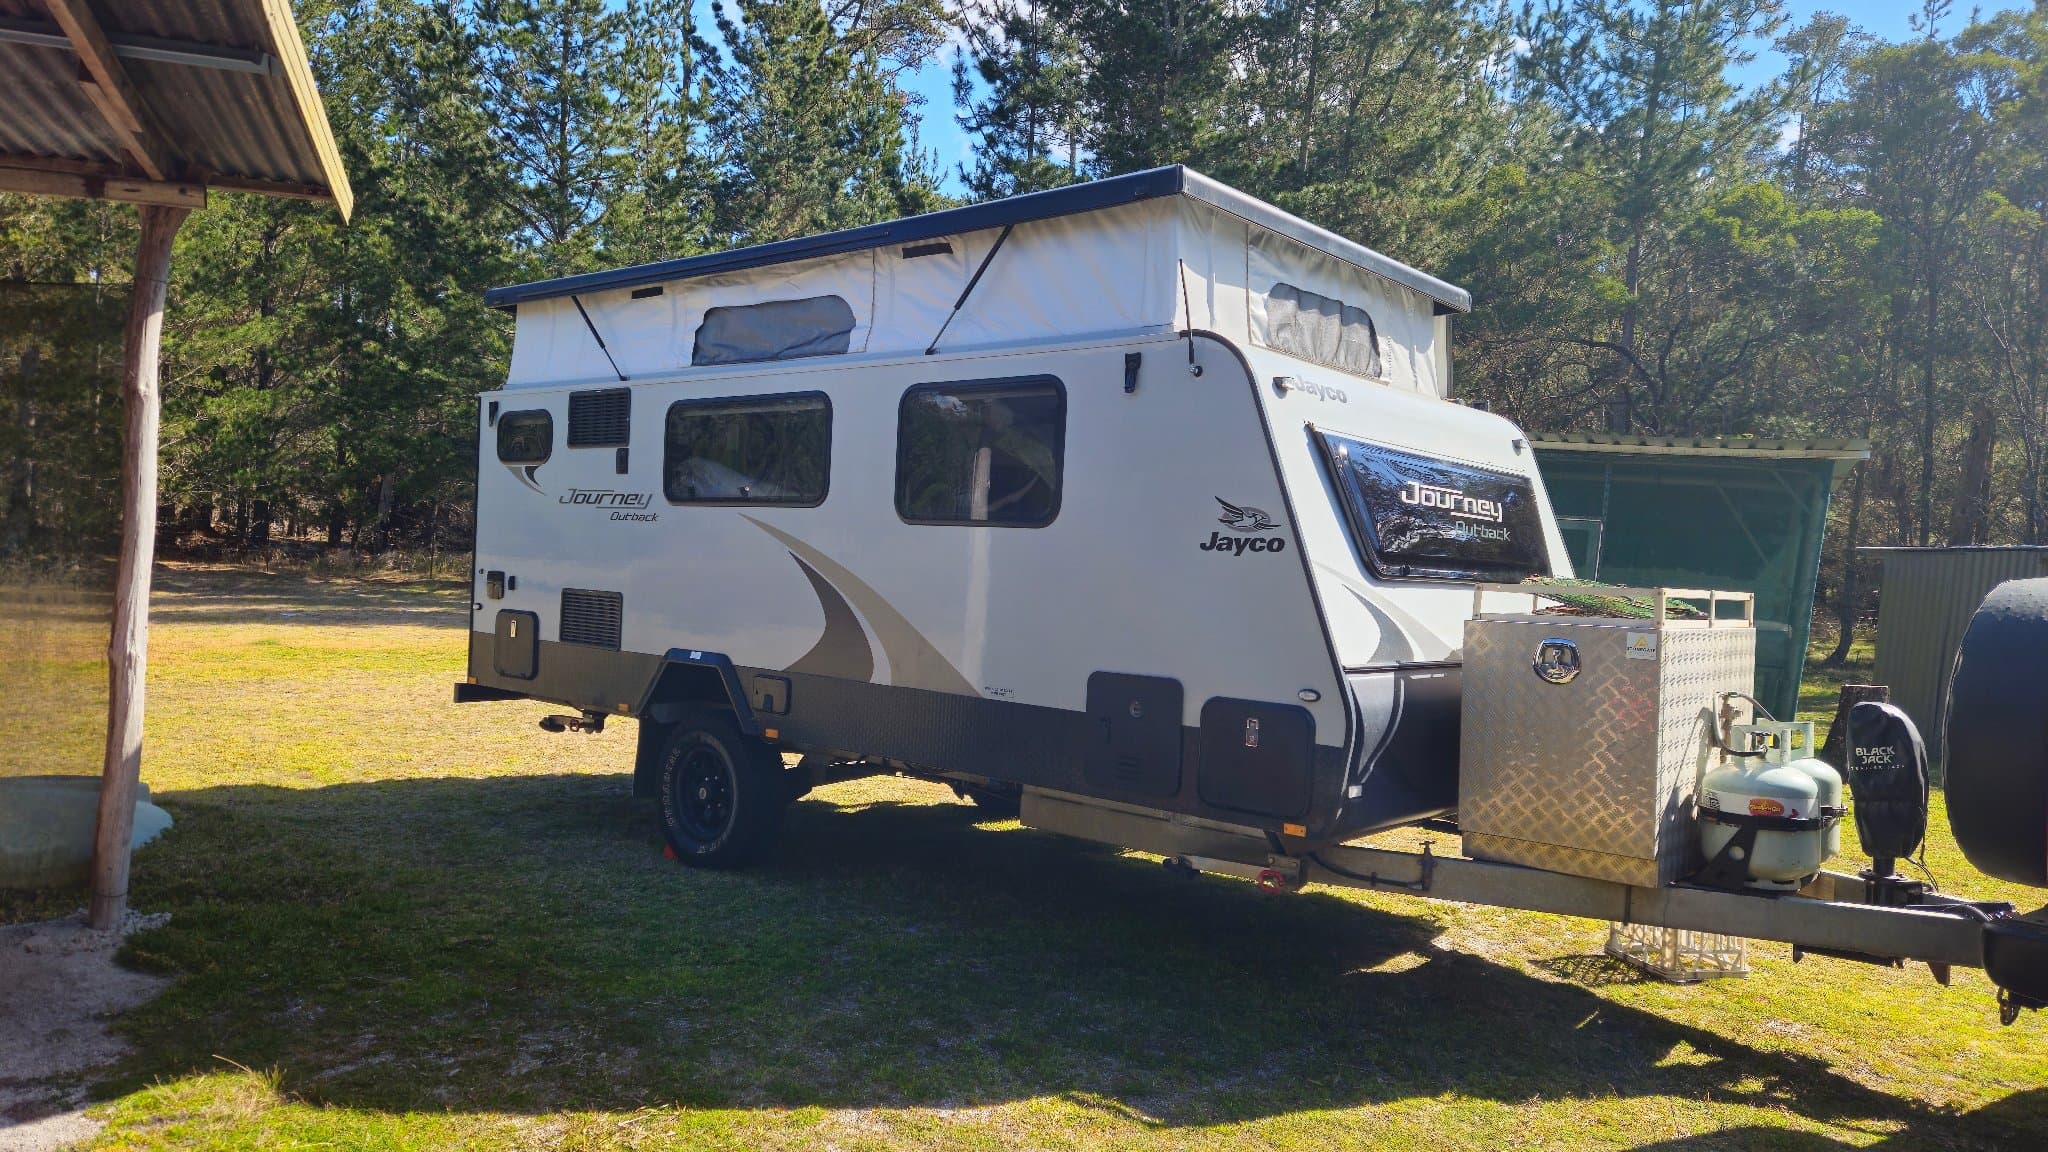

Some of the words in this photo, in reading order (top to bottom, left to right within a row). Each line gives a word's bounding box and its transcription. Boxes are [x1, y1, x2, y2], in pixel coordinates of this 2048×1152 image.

[1296, 374, 1348, 403] Jayco
[559, 488, 653, 510] Journey
[1401, 480, 1503, 522] Journey
[610, 511, 659, 522] Outback
[1456, 520, 1511, 542] Outback
[1200, 532, 1286, 557] Jayco
[1855, 746, 1896, 756] BLACK
[1862, 755, 1892, 765] JACK
